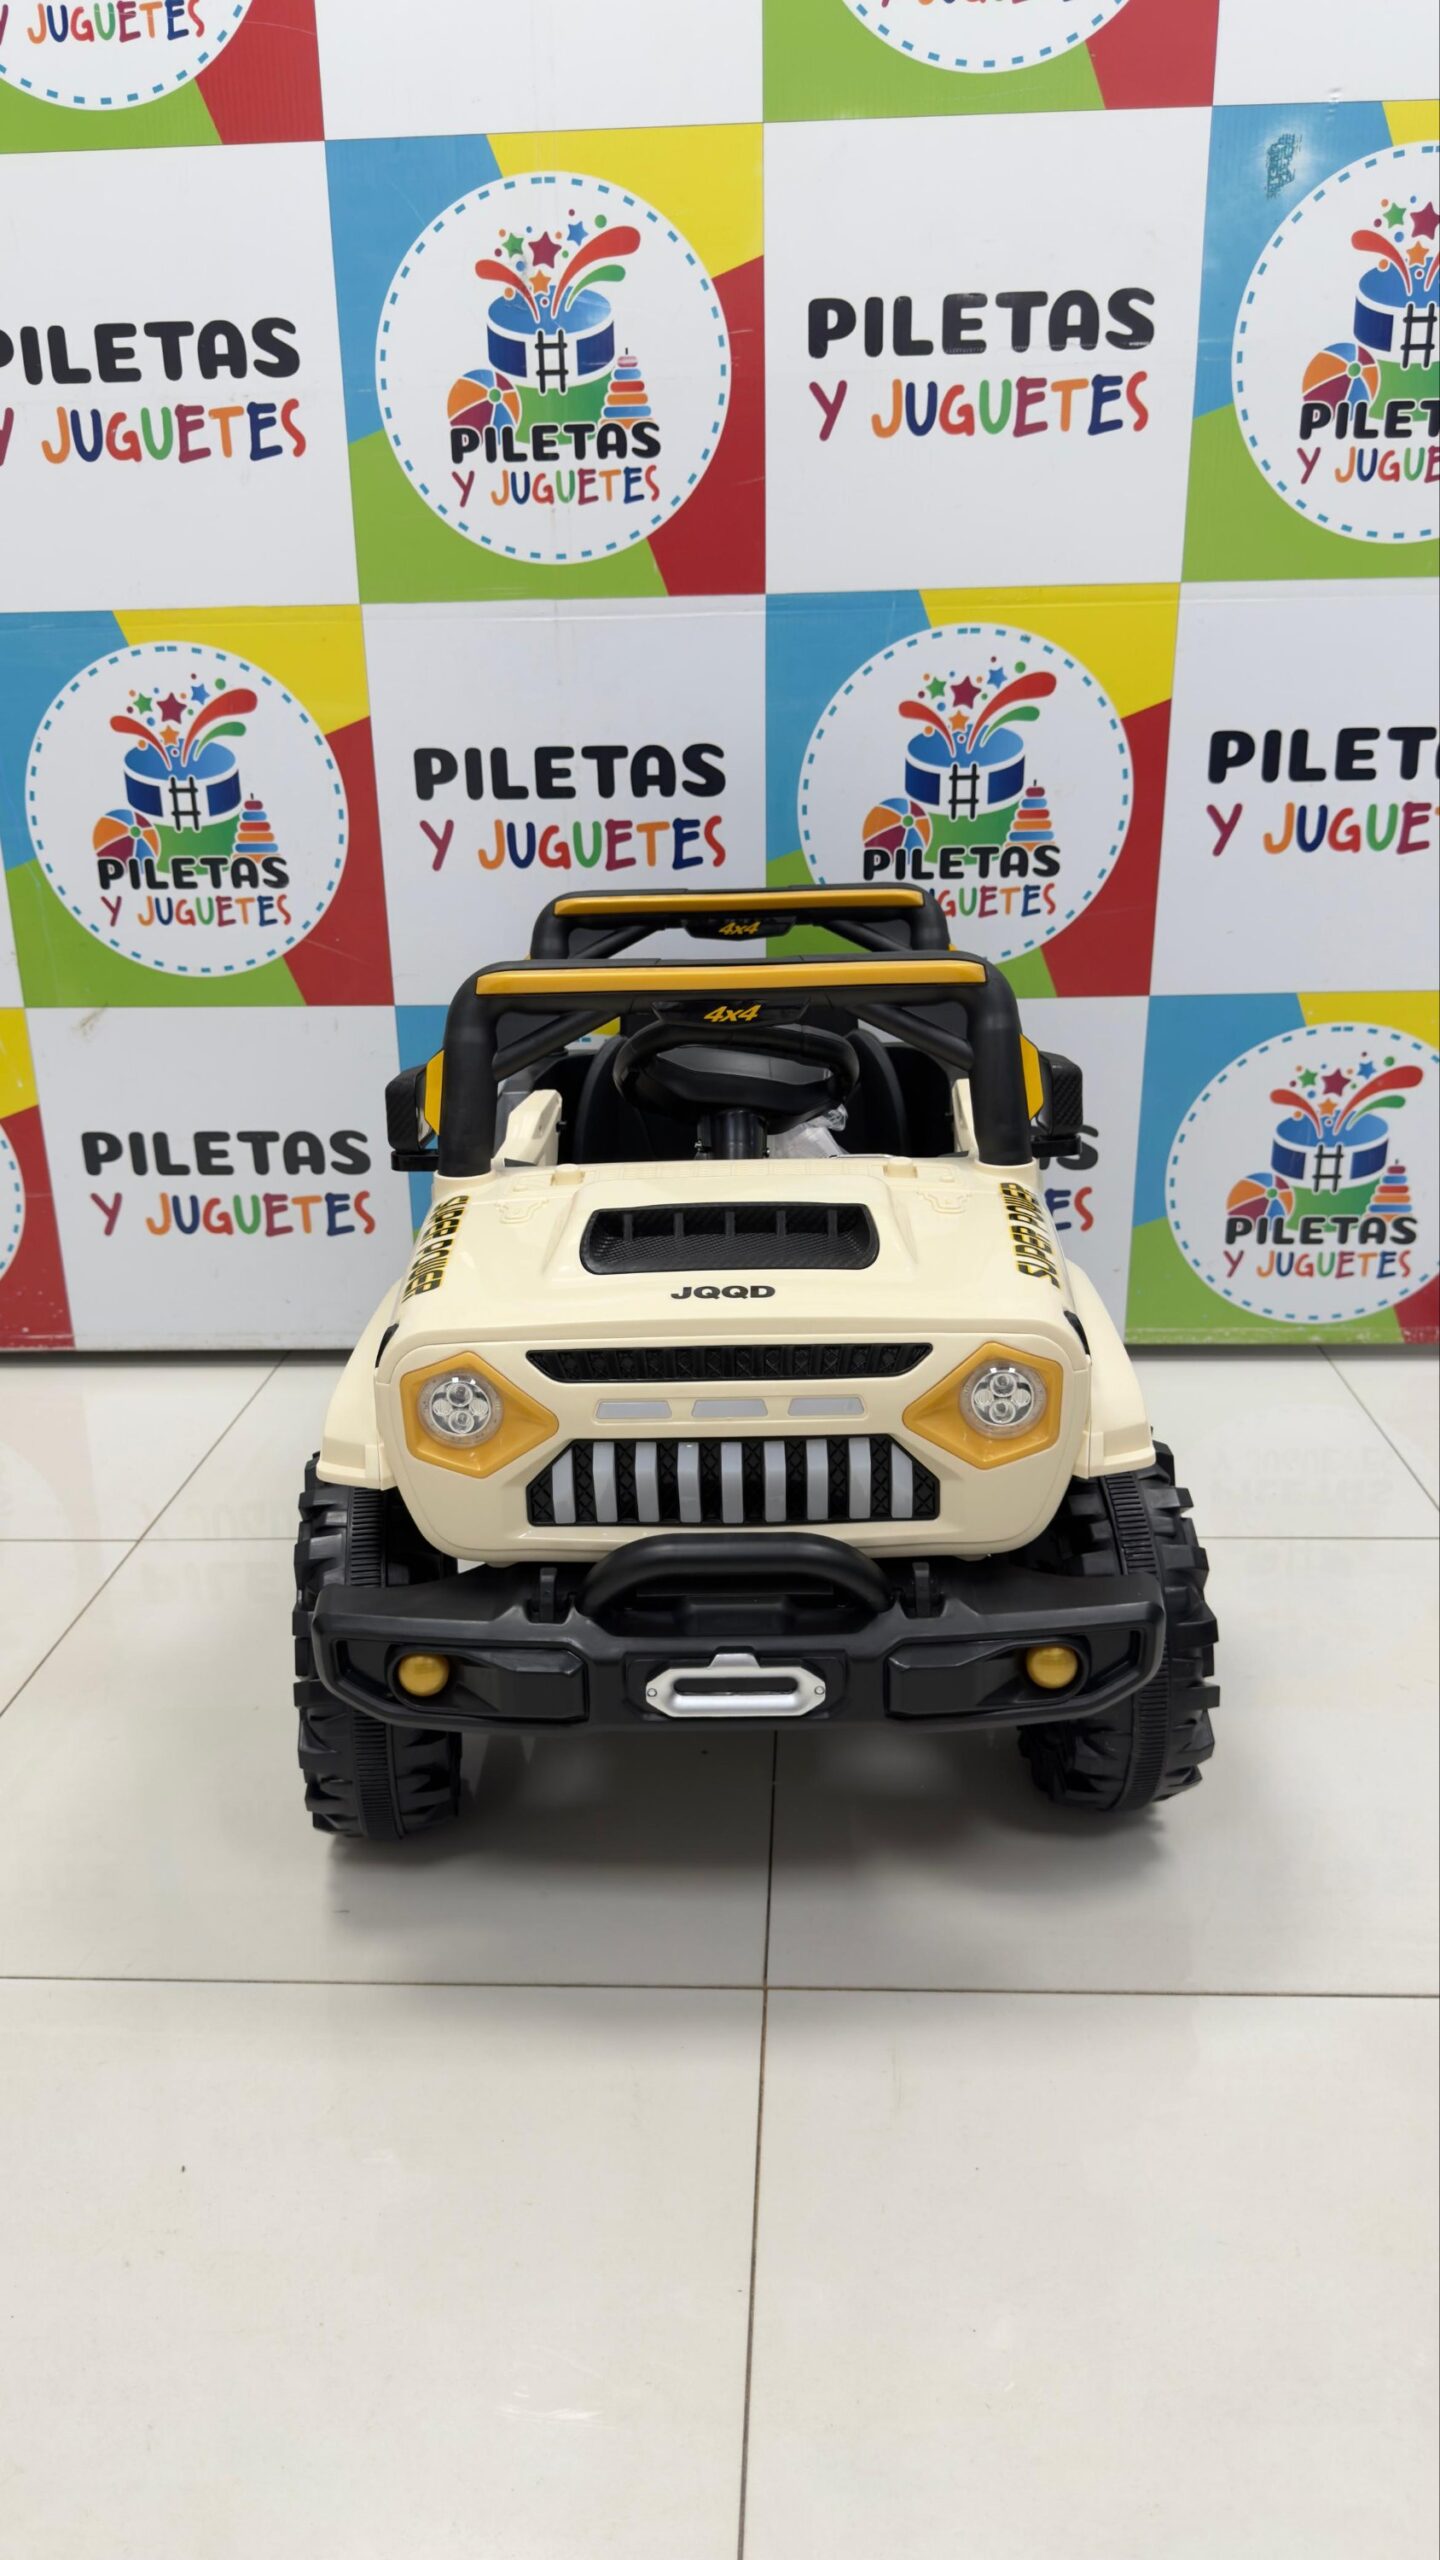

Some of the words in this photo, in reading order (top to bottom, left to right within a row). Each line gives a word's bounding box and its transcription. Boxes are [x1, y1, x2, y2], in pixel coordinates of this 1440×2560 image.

[27, 0, 205, 44] JUGUETES
[808, 287, 1155, 359] PILETAS
[809, 380, 847, 441] Y
[871, 371, 1149, 439] JUGUETES
[40, 398, 307, 464] JUGUETES
[450, 421, 661, 464] PILETAS
[451, 470, 475, 507] Y
[490, 464, 660, 507] JUGUETES
[1296, 446, 1322, 485] Y
[413, 743, 726, 801] PILETAS
[1208, 726, 1439, 784] PILET
[419, 819, 454, 872] Y
[478, 815, 727, 870] JUGUETES
[1206, 803, 1243, 857] Y
[1263, 801, 1439, 855] JUGUE
[97, 856, 289, 890] PILETAS
[863, 845, 1061, 881] PILETAS
[100, 896, 122, 927] Y
[137, 895, 292, 927] JUGUETES
[930, 882, 1056, 918] GUETES
[718, 921, 761, 935] 4x4
[703, 1004, 762, 1023] 4x4
[81, 1130, 371, 1176] PILETAS
[90, 1193, 122, 1236] Y
[145, 1191, 376, 1237] JUGUETES
[1225, 1216, 1418, 1246] PILETAS
[1011, 1225, 1061, 1289] SUPER
[1223, 1250, 1244, 1278] Y
[1257, 1250, 1411, 1279] JUGUETES
[670, 1285, 776, 1300] JQQD
